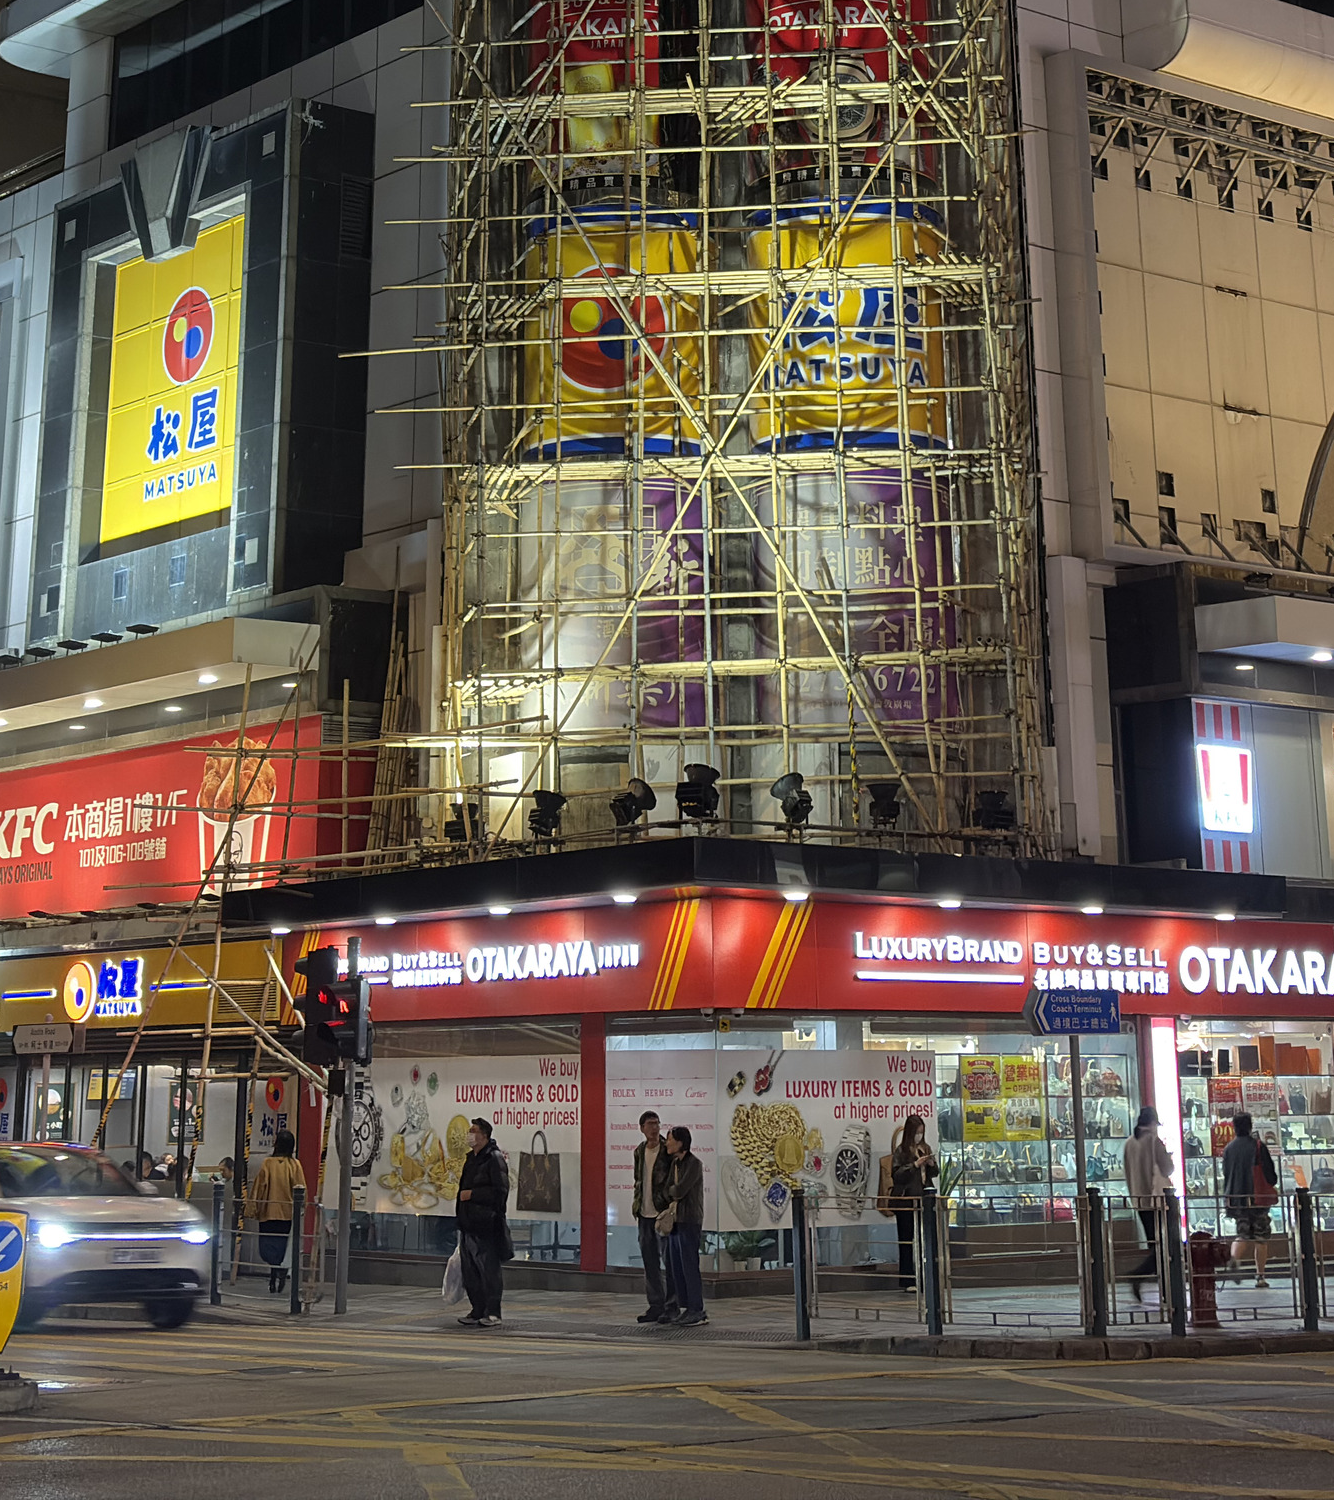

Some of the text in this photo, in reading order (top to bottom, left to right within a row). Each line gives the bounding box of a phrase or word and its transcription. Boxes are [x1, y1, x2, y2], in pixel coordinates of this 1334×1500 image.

[147, 386, 220, 465] 松屋
[143, 459, 218, 502] MATSUYA
[15, 861, 53, 884] ORIGINAL
[597, 944, 640, 969] JAPAN
[854, 931, 1023, 963] LUXURYBRAND
[1033, 943, 1168, 967] BUY&SELL
[392, 951, 463, 971] BUY&SELL
[467, 940, 597, 984] OTAKARAYA
[95, 1001, 142, 1017] MATSUYA
[1050, 994, 1102, 1004] Cross Boundary
[1051, 1004, 1103, 1013] Coach Terminus
[1052, 1017, 1109, 1029] 過境巴士總站
[539, 1058, 579, 1080] We buy
[887, 1055, 932, 1078] We buy
[456, 1083, 579, 1104] LUXURY ITEMS & GOLD
[785, 1079, 933, 1099] LUXURY ITEMS & GOLD
[493, 1108, 579, 1130] at higher prices!
[834, 1100, 934, 1123] at higher prices!
